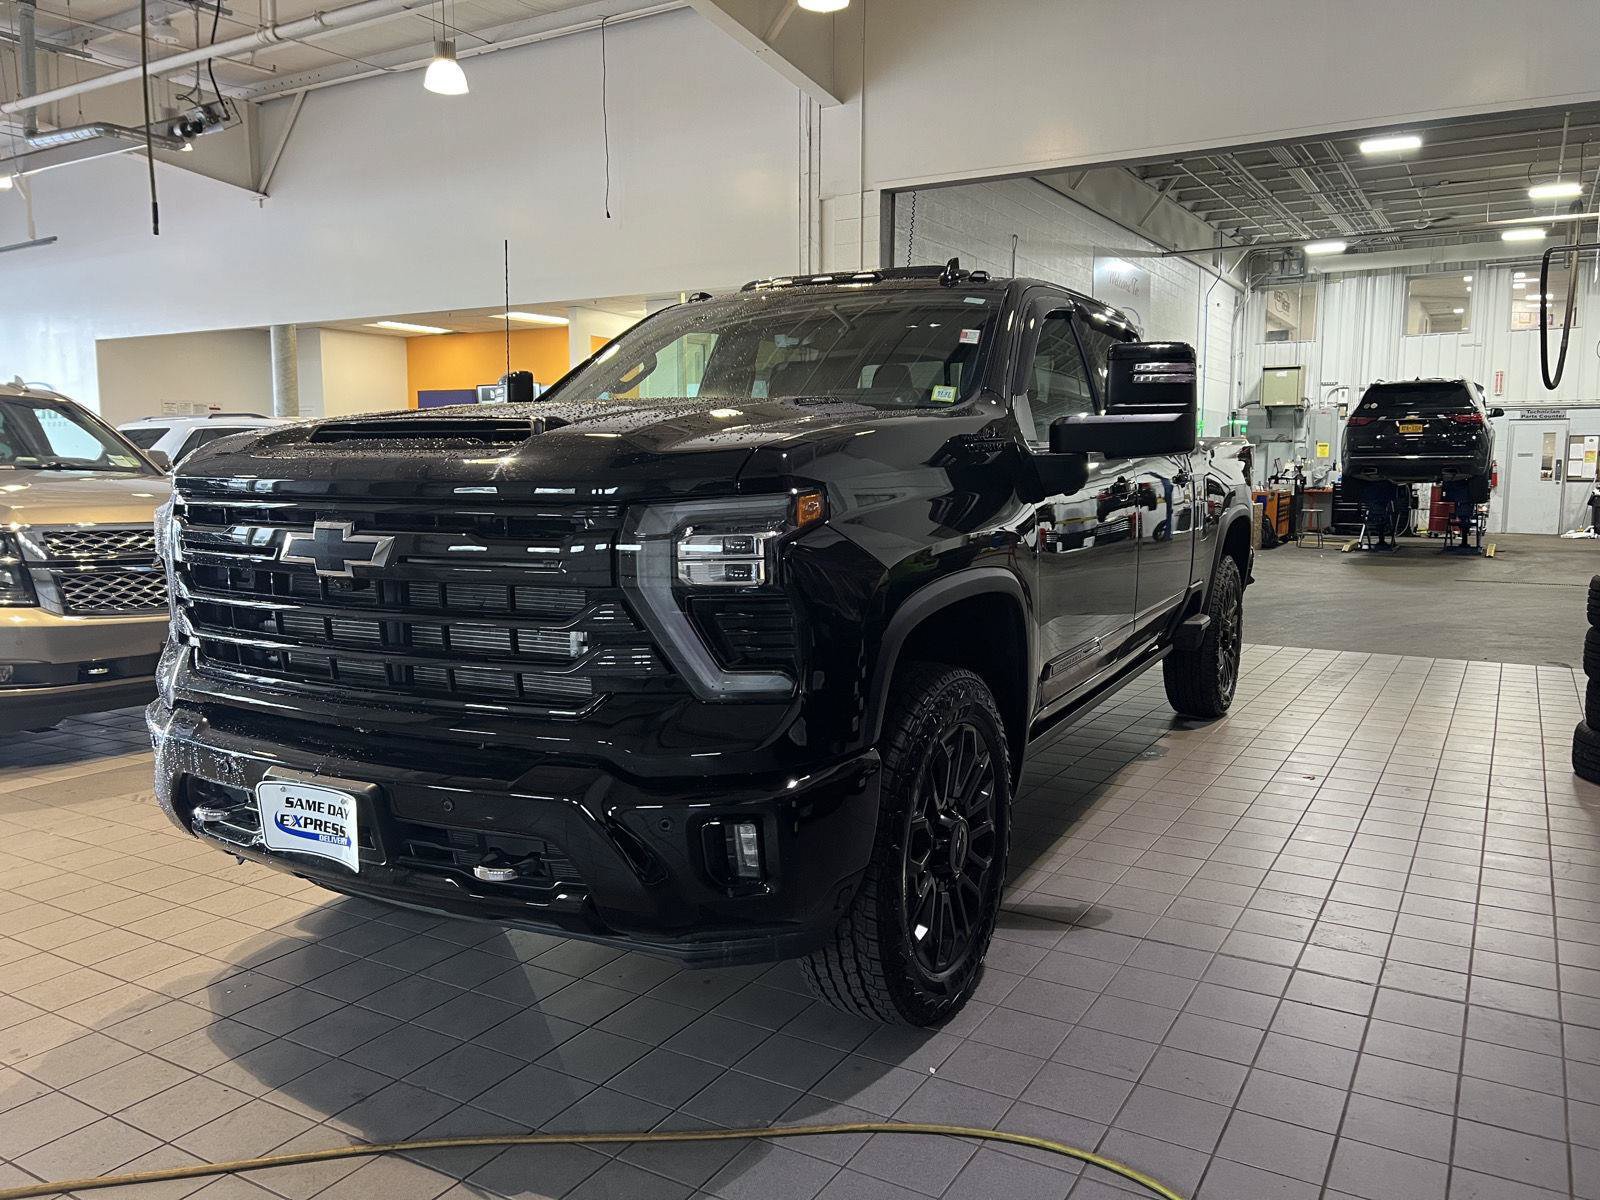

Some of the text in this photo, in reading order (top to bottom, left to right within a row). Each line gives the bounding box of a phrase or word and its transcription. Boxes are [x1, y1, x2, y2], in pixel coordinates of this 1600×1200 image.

[284, 796, 350, 821] SAME DAY
[280, 813, 347, 838] EXPRESS
[319, 834, 348, 846] DELIVERY
